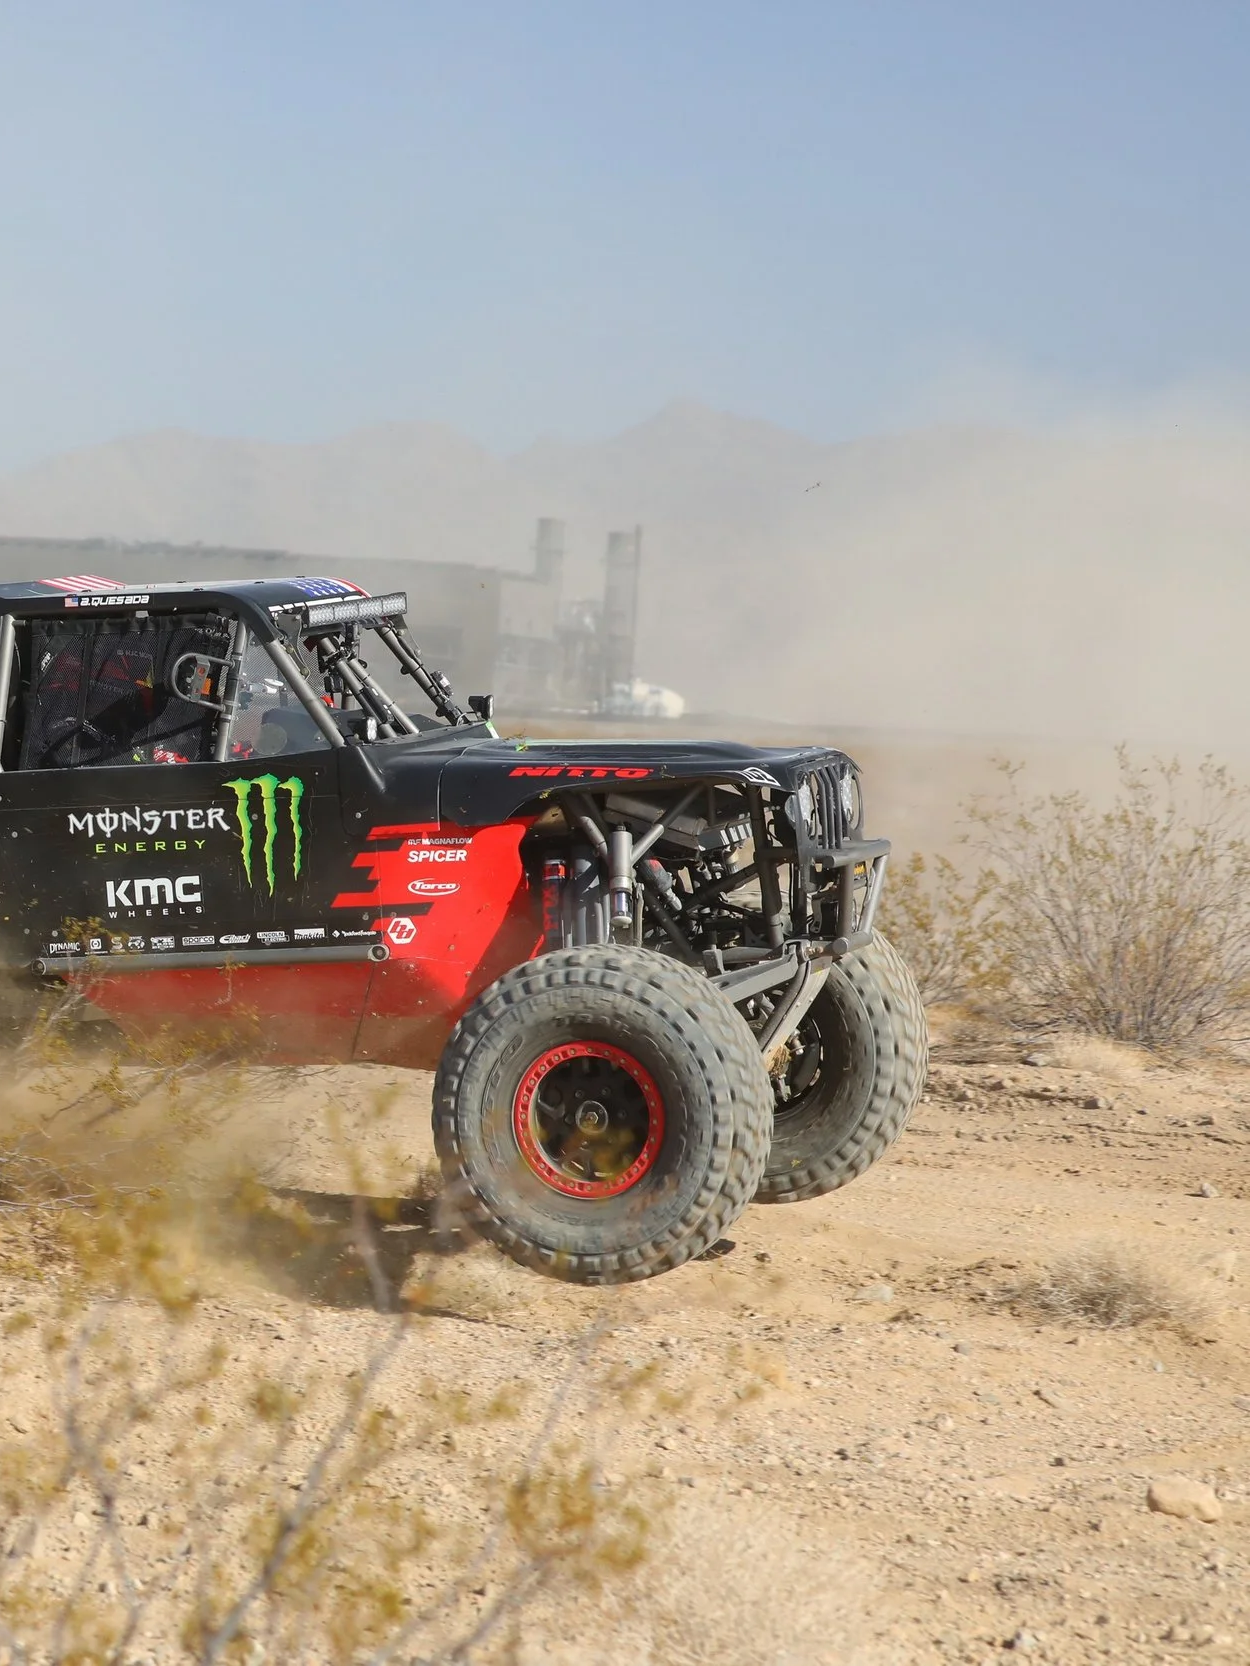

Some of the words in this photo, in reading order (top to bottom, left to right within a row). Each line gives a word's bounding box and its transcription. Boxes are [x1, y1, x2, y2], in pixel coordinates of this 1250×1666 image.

[67, 806, 231, 838] MONSTER
[95, 839, 206, 854] ENERGY
[407, 849, 468, 863] SPICER
[414, 882, 457, 890] Torco
[108, 906, 203, 919] WHEELS
[49, 942, 81, 954] DYNAMIC
